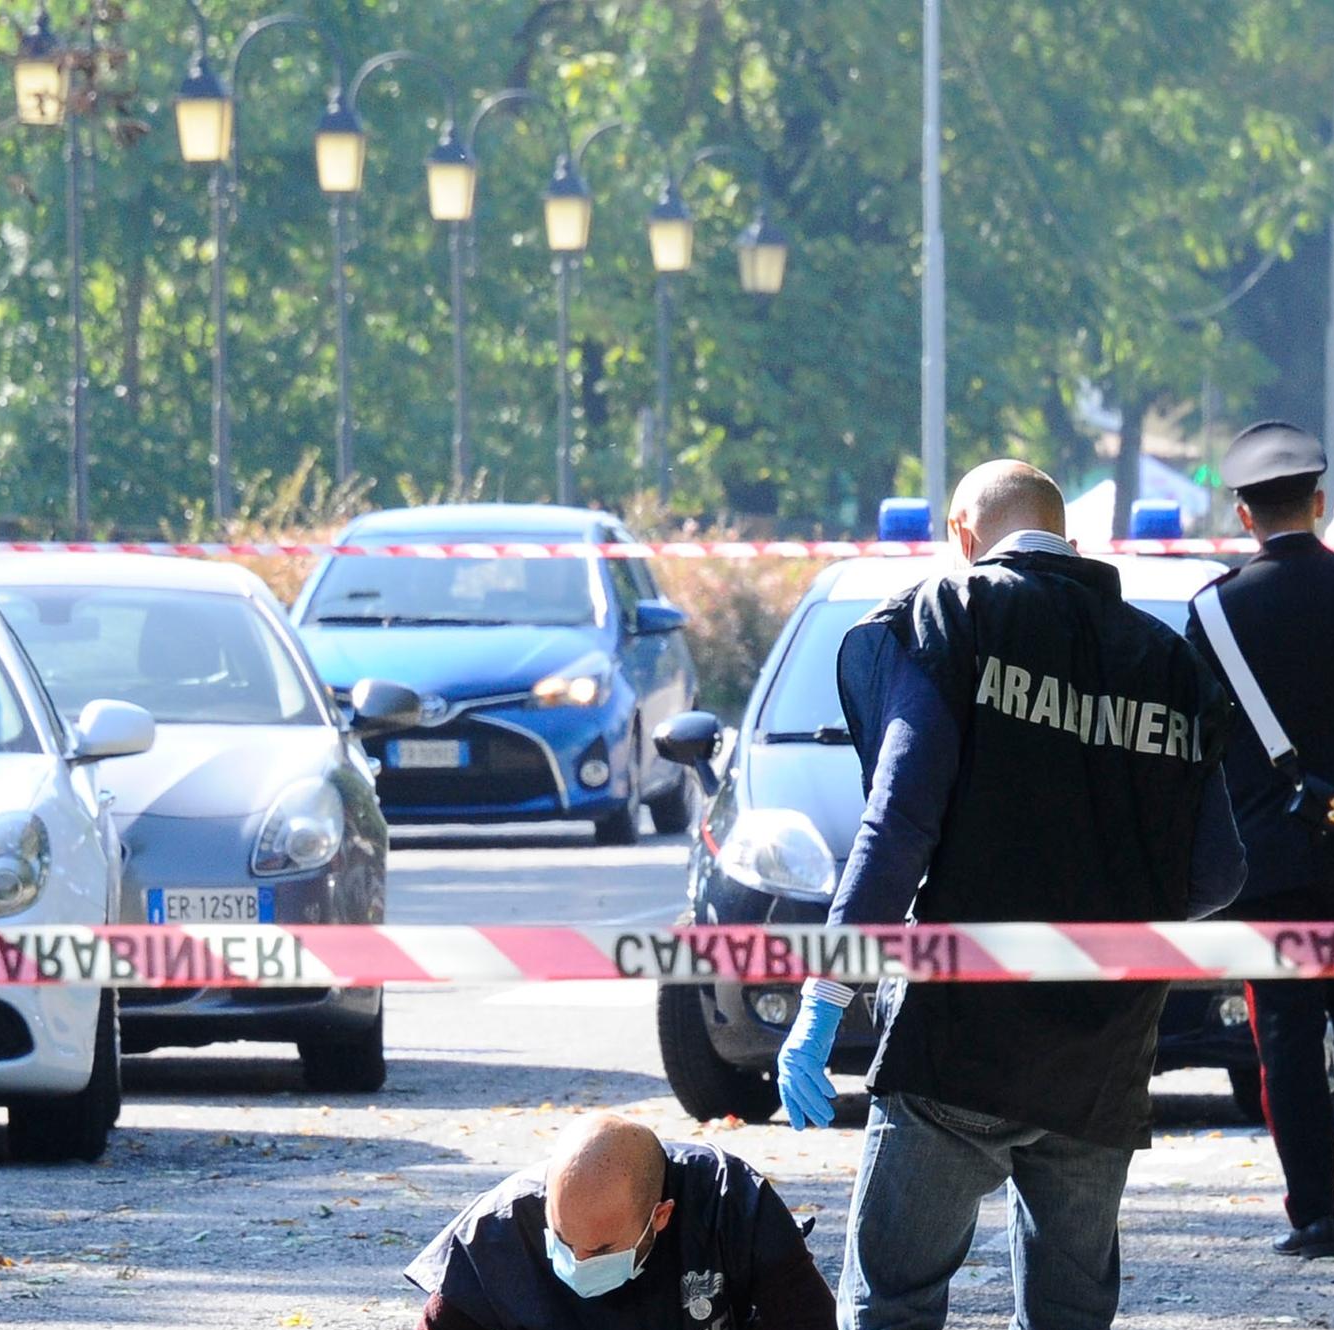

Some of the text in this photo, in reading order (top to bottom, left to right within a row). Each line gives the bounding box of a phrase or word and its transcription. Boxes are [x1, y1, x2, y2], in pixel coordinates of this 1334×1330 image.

[975, 655, 1203, 763] ARABINIERI
[168, 895, 192, 919] ER
[200, 895, 258, 920] 125YB
